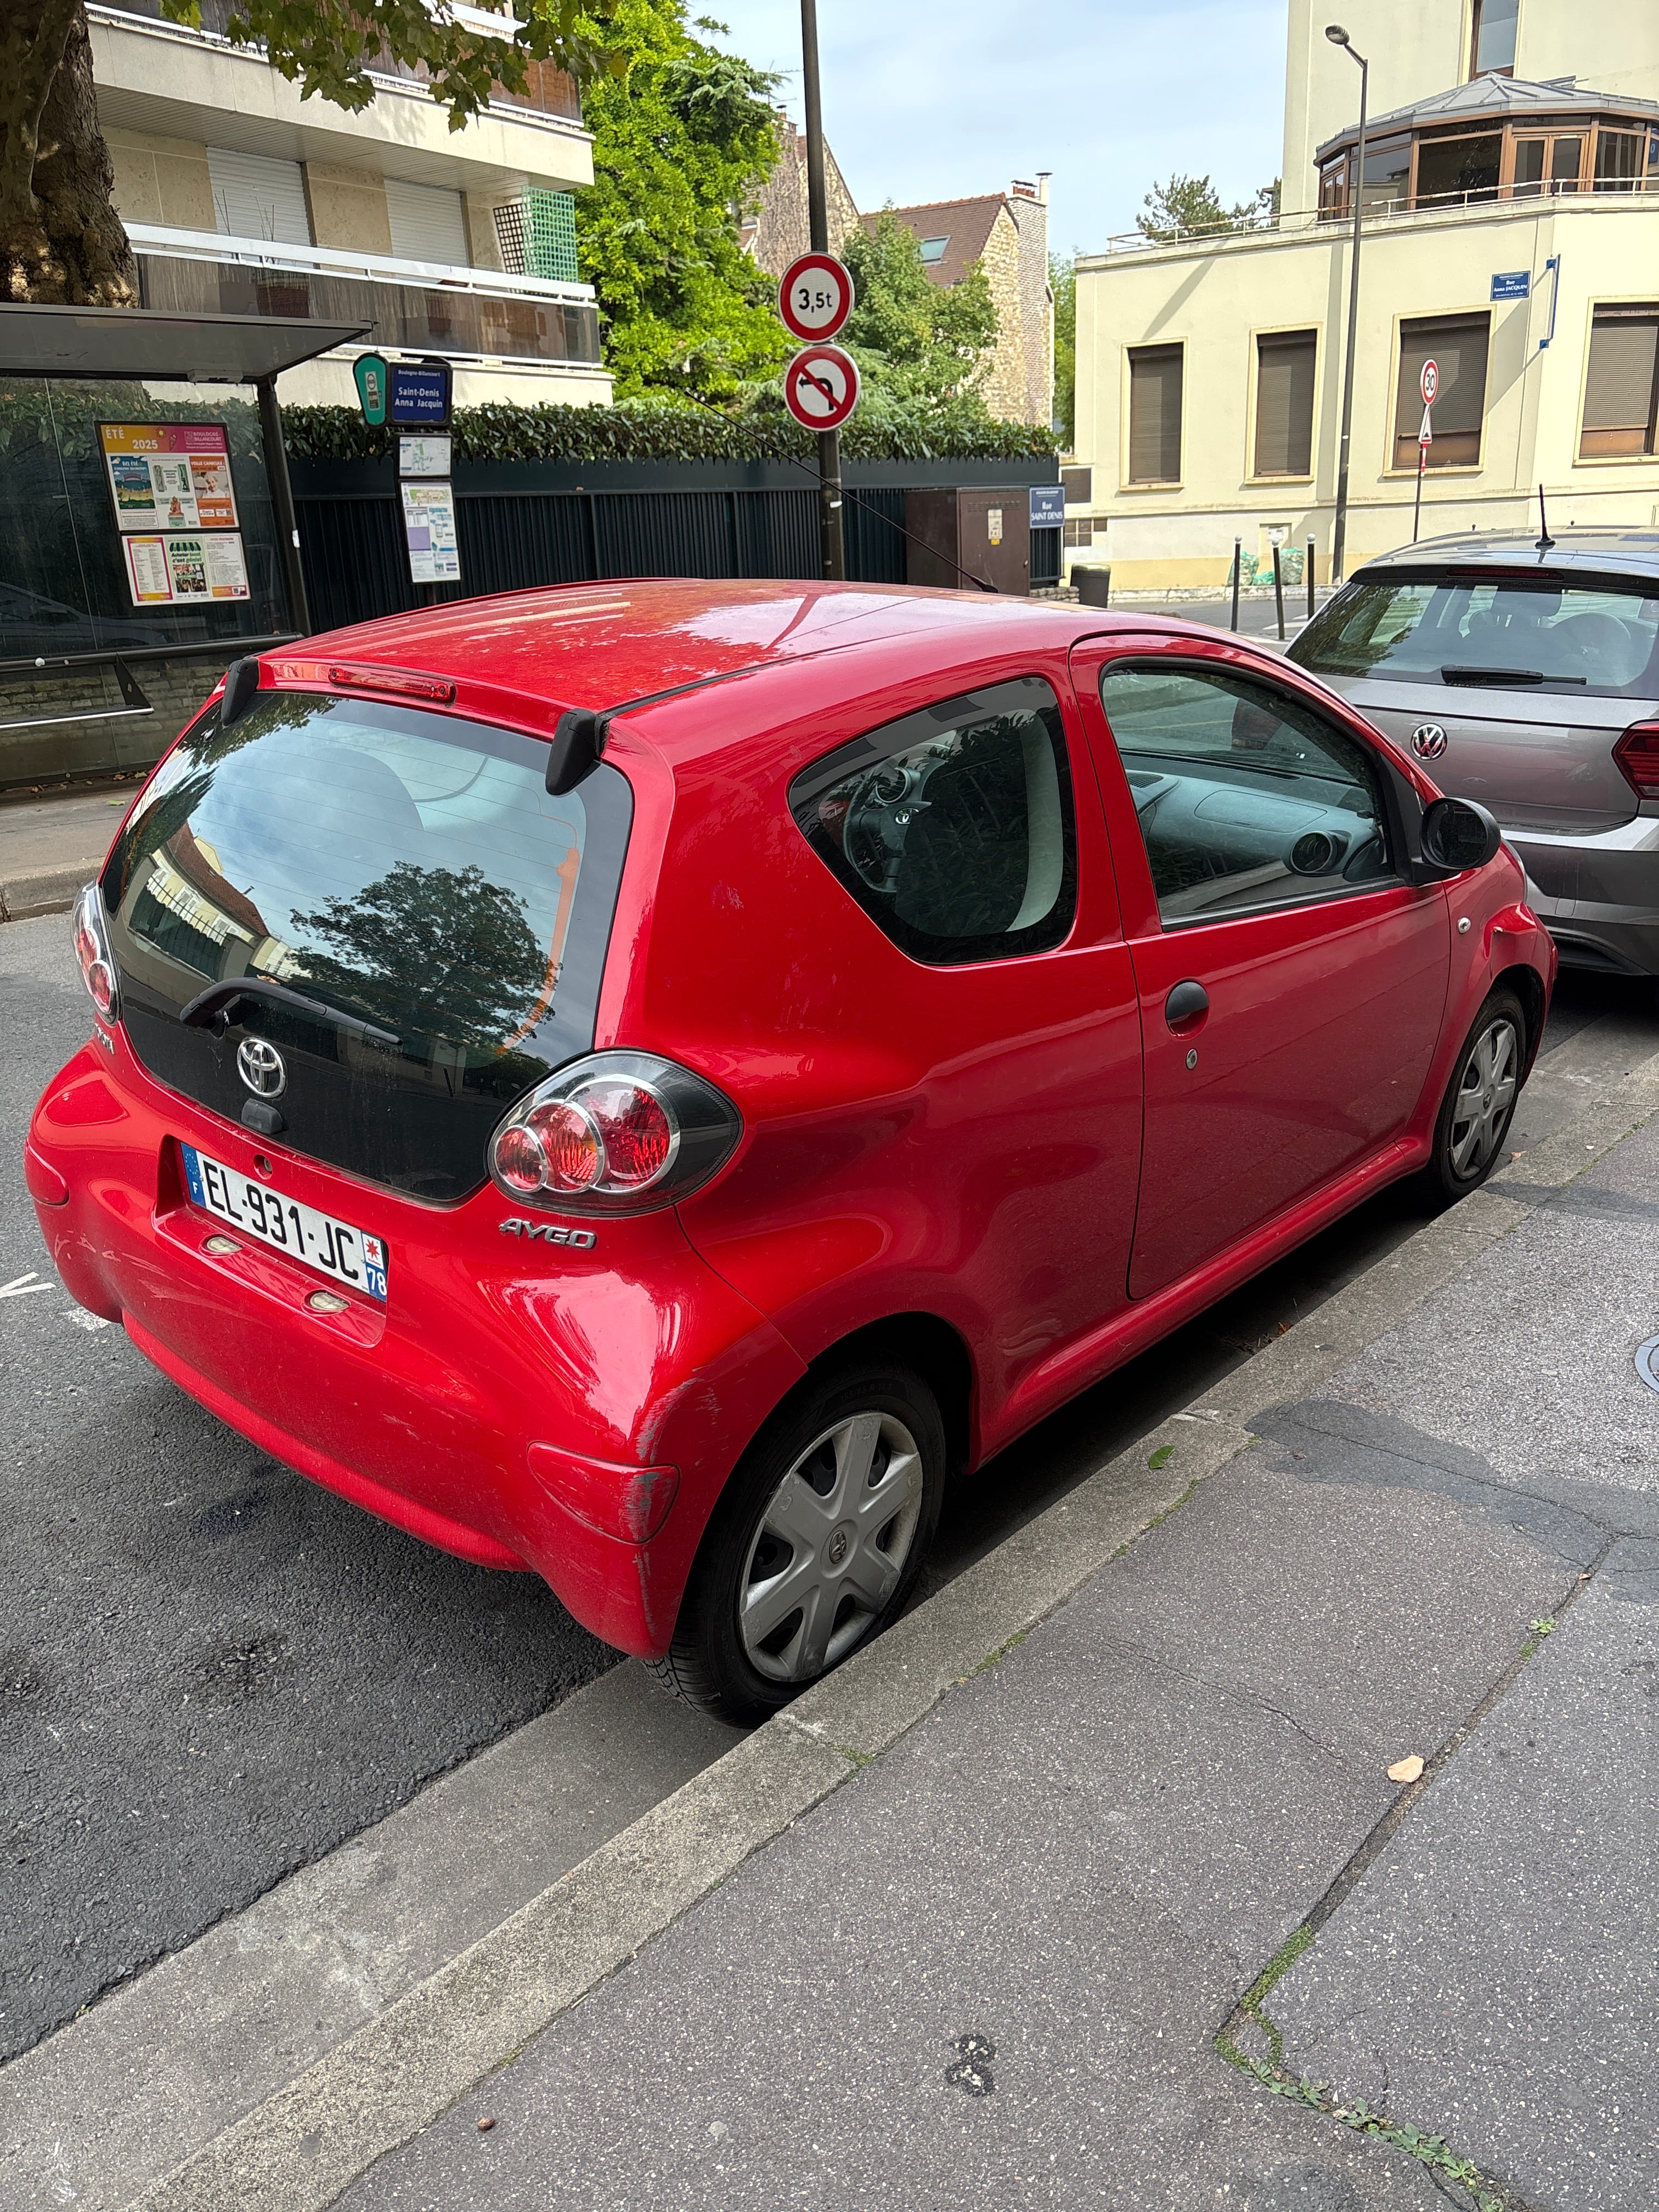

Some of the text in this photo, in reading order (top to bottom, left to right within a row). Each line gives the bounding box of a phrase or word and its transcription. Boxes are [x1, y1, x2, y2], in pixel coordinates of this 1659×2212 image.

[1426, 374, 1435, 391] 30
[398, 387, 439, 397] Saint-Denis
[394, 398, 443, 409] Anna Jacquin
[105, 426, 125, 439] ÉTÉ
[132, 439, 159, 450] 2025
[1042, 501, 1052, 510] Rue
[1031, 511, 1063, 521] SAINT DENIS
[192, 1181, 199, 1194] F
[499, 1218, 597, 1249] AYGO
[366, 1266, 387, 1296] 78
